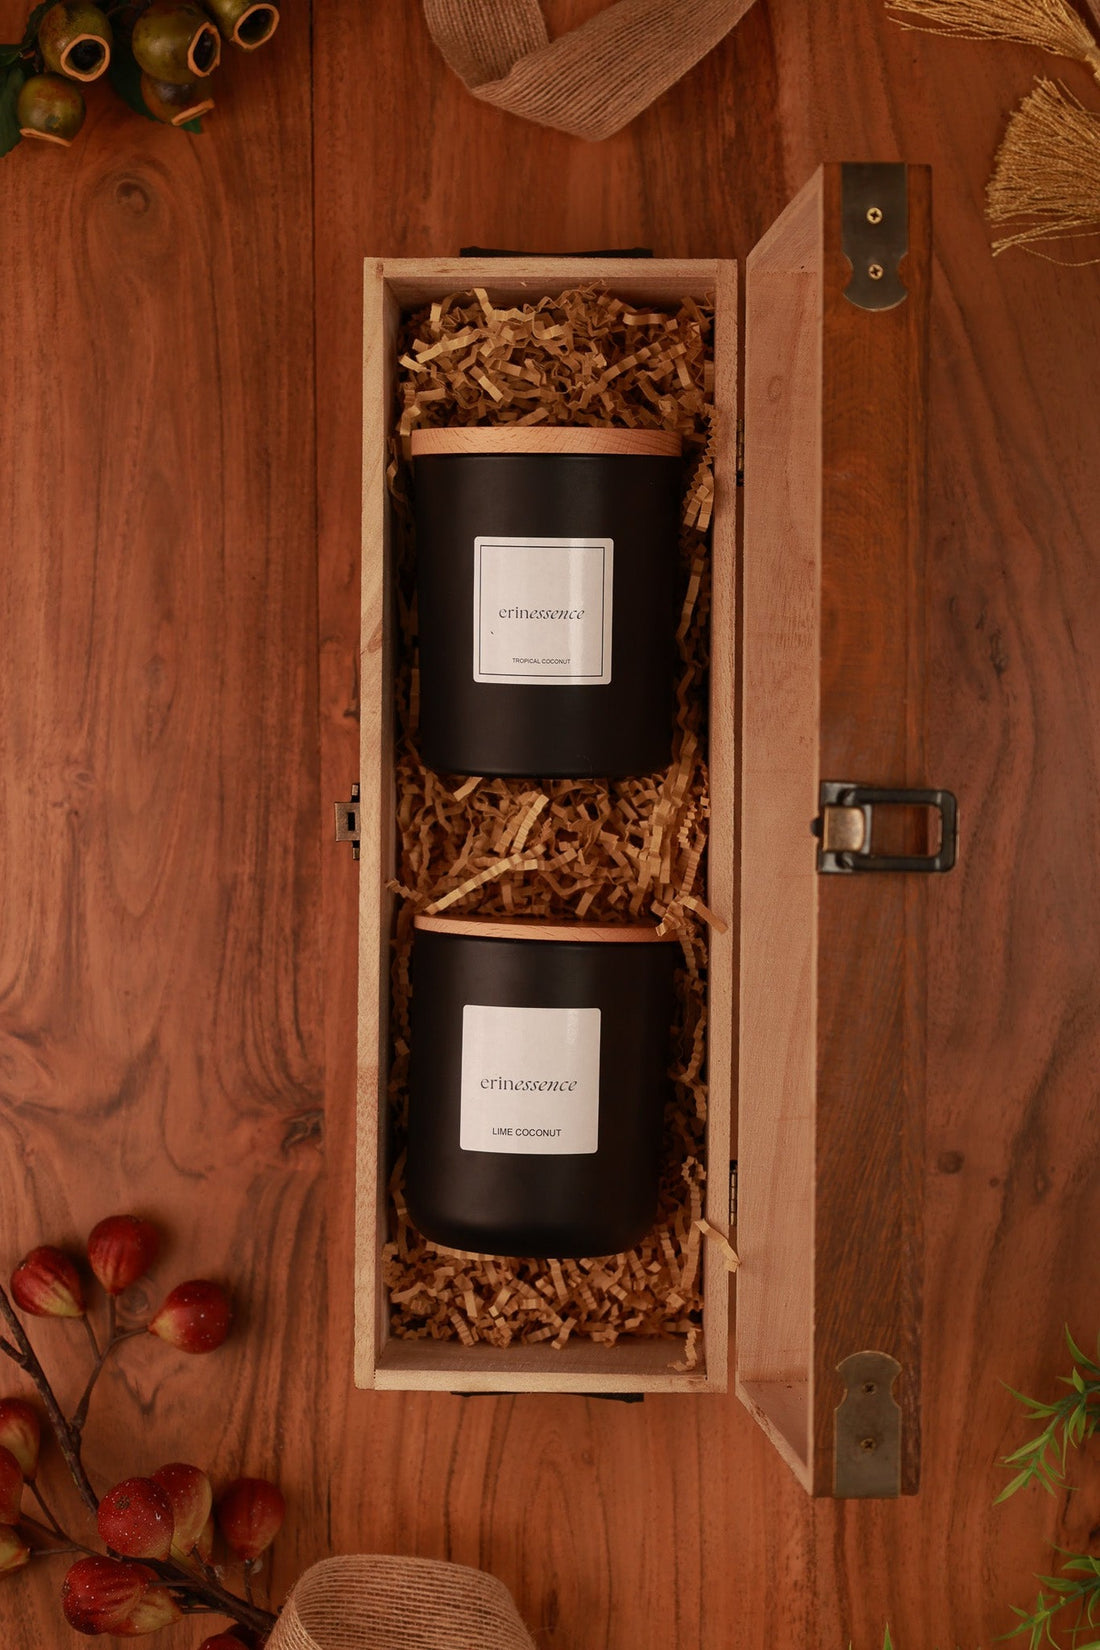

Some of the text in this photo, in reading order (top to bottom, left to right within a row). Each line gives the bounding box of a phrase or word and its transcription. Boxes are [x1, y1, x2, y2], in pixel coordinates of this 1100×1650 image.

[498, 606, 585, 620] erinessence
[480, 1076, 577, 1092] erinessence
[492, 1127, 562, 1137] LIME COCONUT
